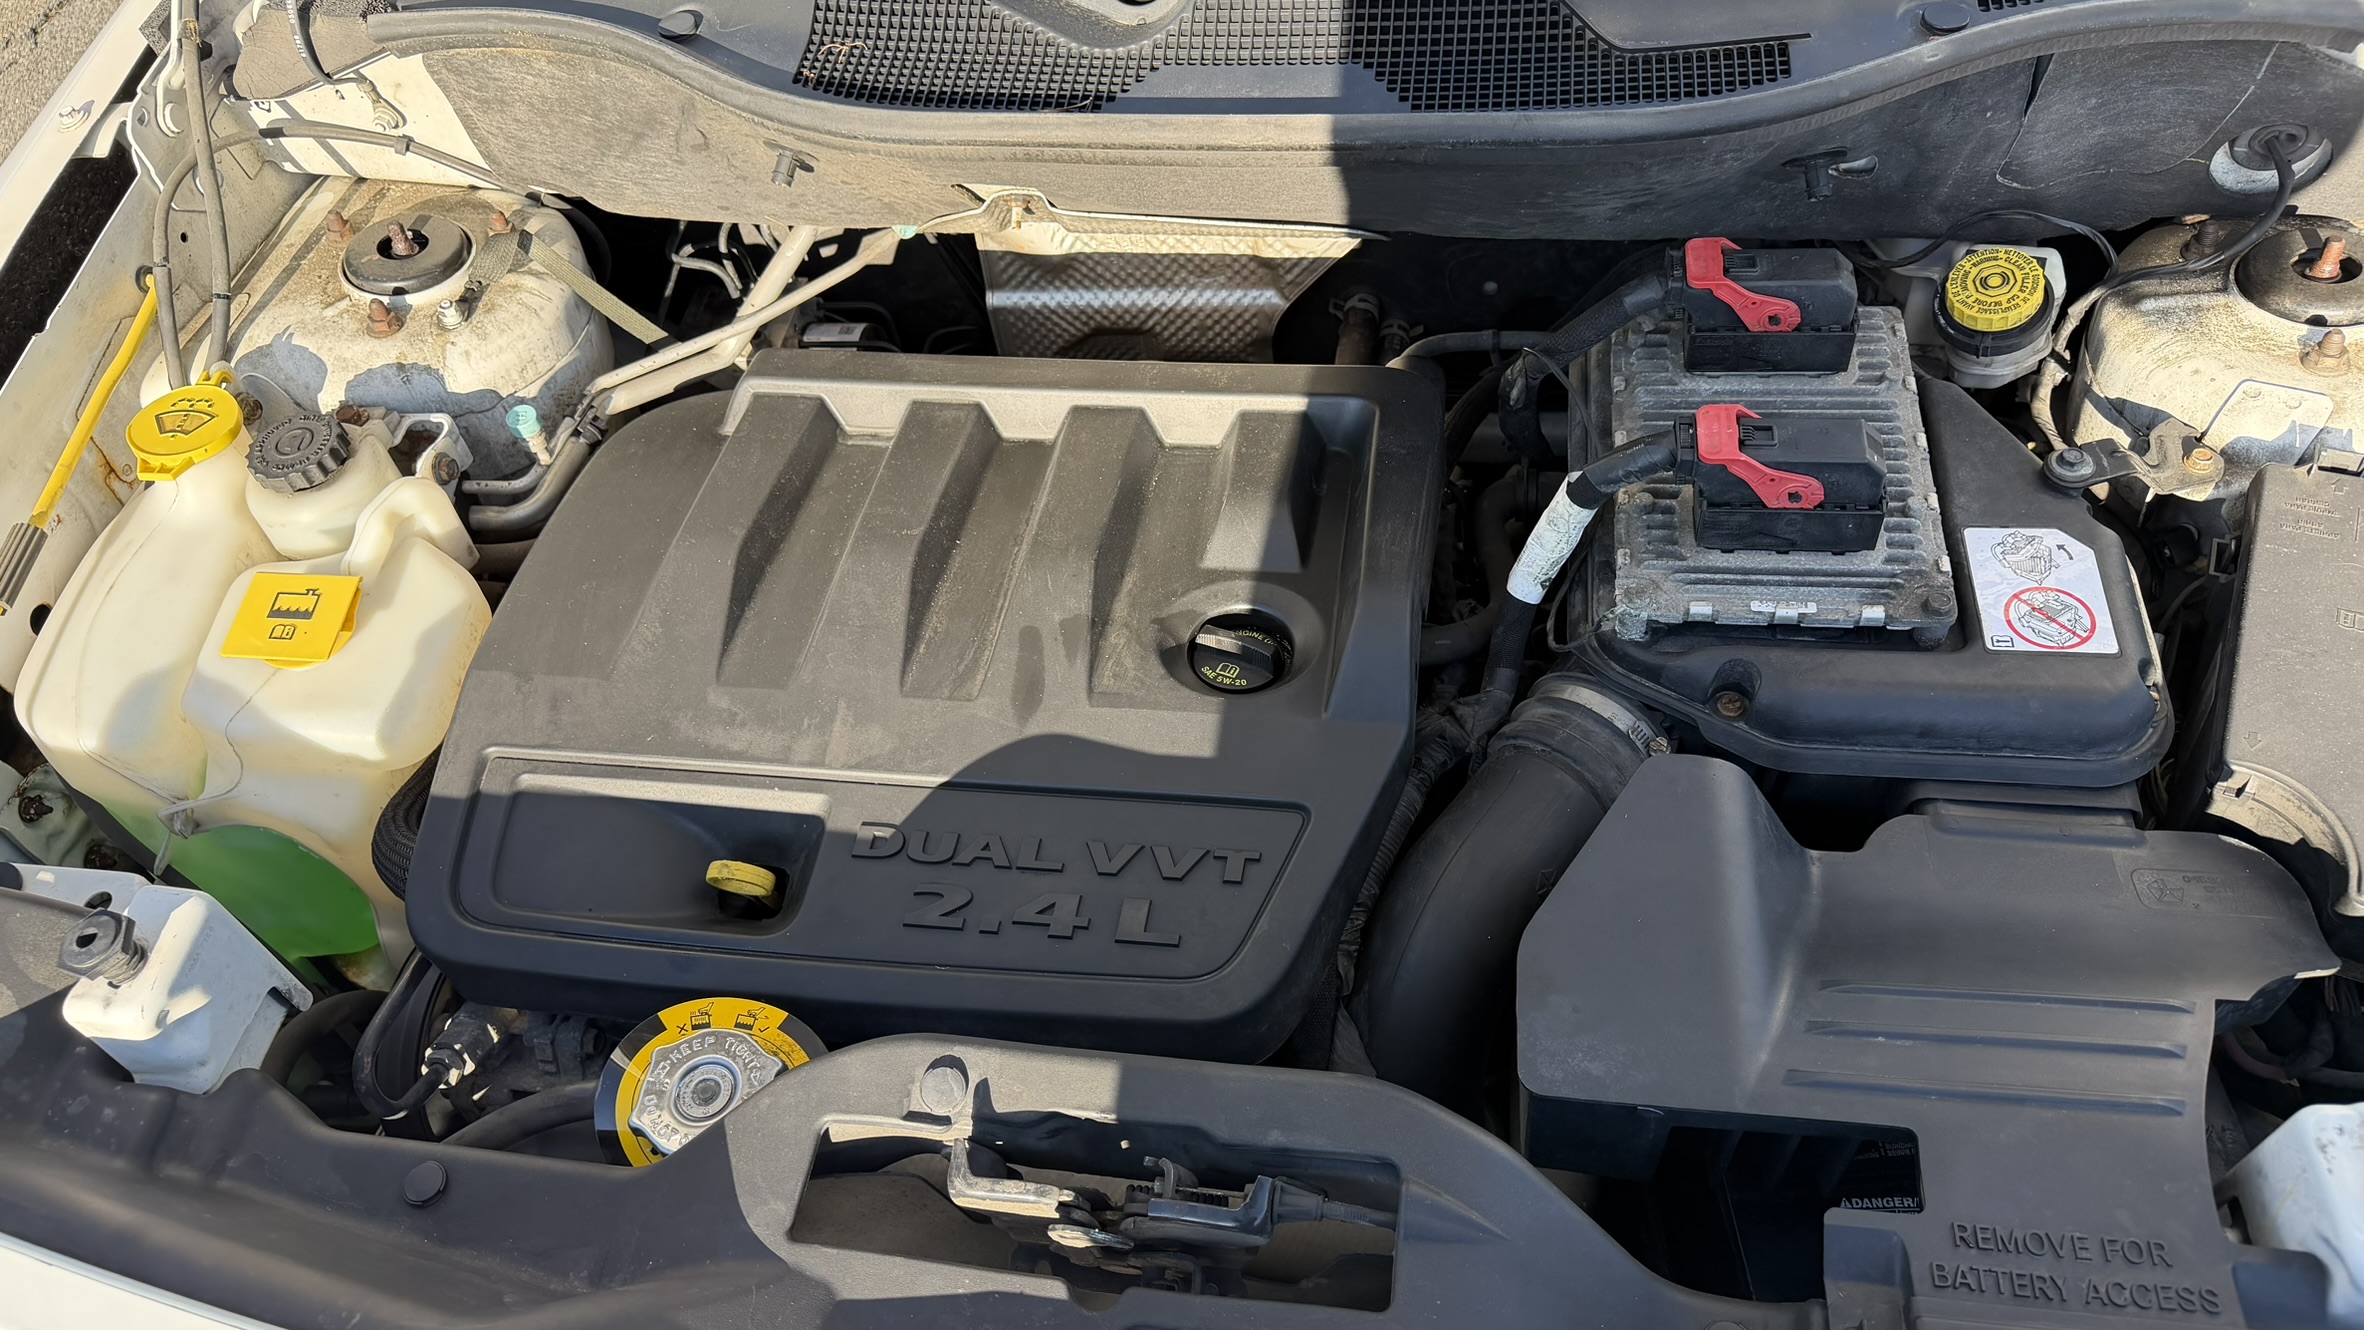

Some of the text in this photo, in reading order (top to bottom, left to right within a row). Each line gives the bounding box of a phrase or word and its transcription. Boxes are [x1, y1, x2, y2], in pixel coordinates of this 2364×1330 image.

[2004, 248, 2033, 267] NETTOYER
[2004, 257, 2027, 272] CLEAN
[2029, 264, 2038, 273] LE
[2019, 272, 2031, 294] FILLER
[1957, 298, 1975, 311] AVANT
[1974, 298, 2004, 307] BEFORE
[2005, 293, 2020, 305] CAP
[1201, 666, 1247, 686] SAE 5W-20
[851, 821, 1262, 885] DUAL VVT
[902, 882, 1182, 949] 2.4 L
[670, 1036, 762, 1072] KEEP TIGHT
[643, 1094, 680, 1143] DO NOT
[1950, 1221, 2174, 1268] REMOVE FOR
[1930, 1261, 2223, 1314] BATTERY ACCESS
